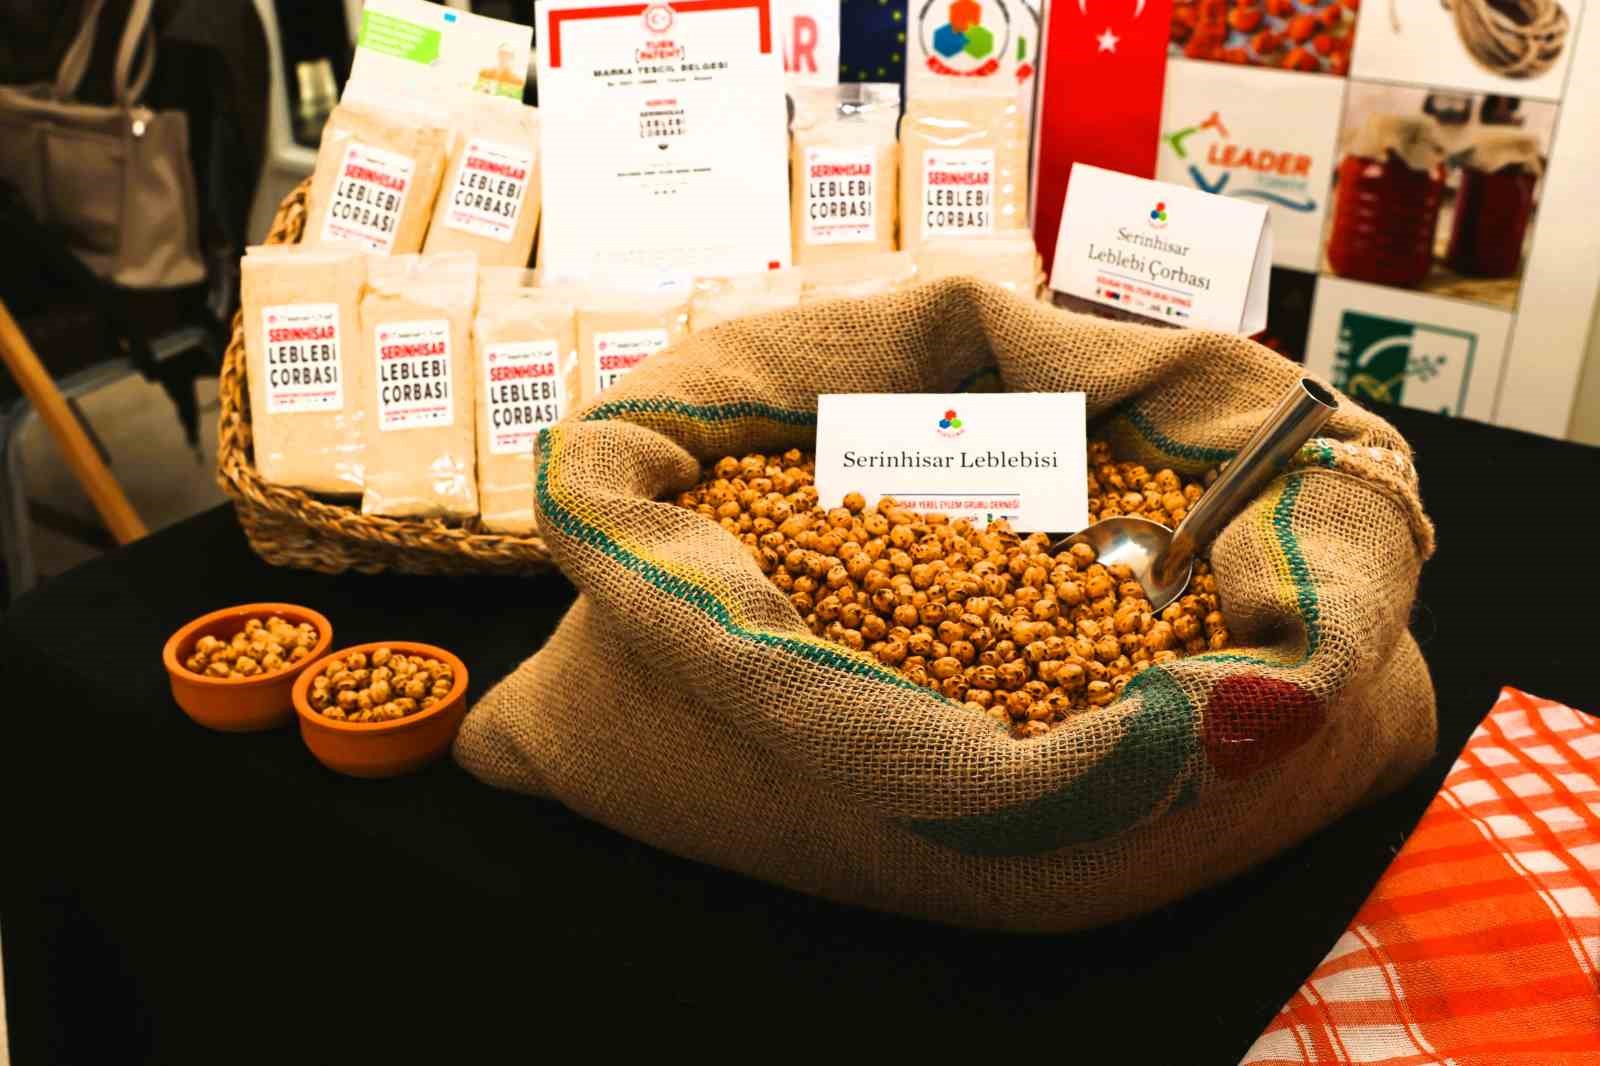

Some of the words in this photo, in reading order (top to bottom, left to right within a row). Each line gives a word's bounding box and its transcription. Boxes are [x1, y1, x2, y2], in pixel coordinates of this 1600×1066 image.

[1208, 143, 1312, 177] LEADER
[1117, 227, 1191, 257] Serinhisar
[1088, 243, 1145, 273] Leblebi
[1148, 260, 1211, 290] Çorbası
[270, 366, 337, 388] ÇORBASI
[382, 382, 447, 405] ÇORBASI
[492, 404, 558, 429] ÇORBASI
[843, 451, 954, 469] Serinhisar
[960, 451, 1058, 469] Leblebisi
